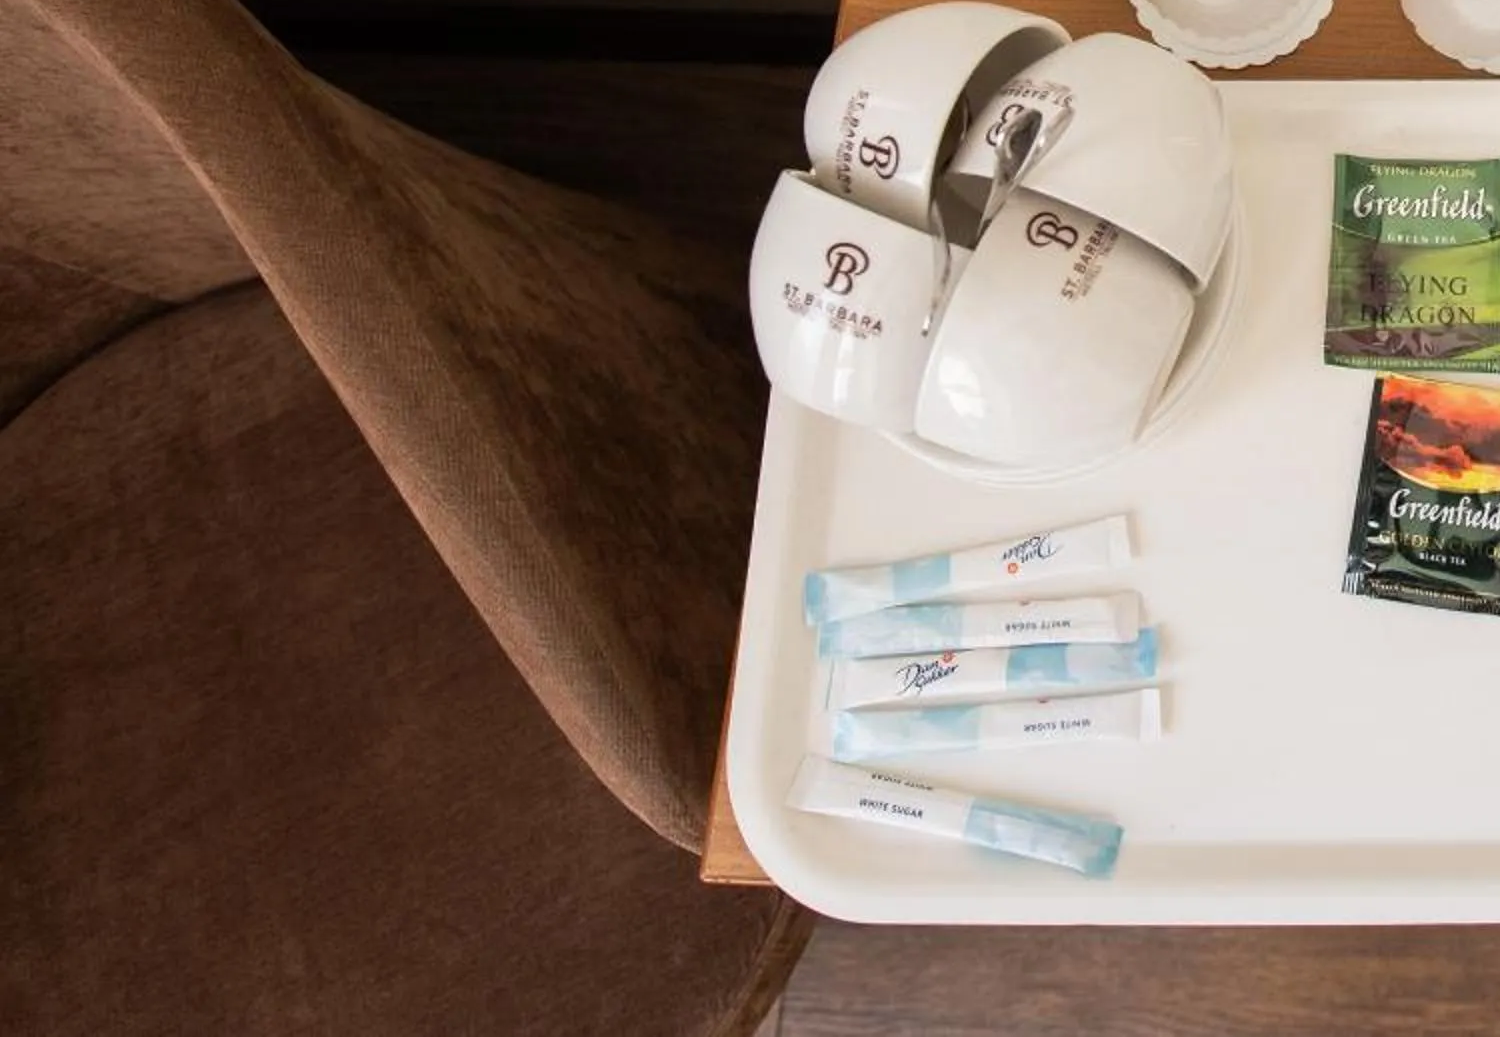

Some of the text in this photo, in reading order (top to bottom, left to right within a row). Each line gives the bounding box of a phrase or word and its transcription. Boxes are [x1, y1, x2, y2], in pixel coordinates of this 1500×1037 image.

[1419, 164, 1477, 180] DRAGON
[1353, 184, 1486, 220] Greenfield
[1026, 211, 1079, 250] B
[825, 242, 870, 295] B
[1358, 302, 1477, 326] DRAGON
[1418, 551, 1467, 566] BLACK TEA
[859, 797, 924, 819] WHITE SUGAR
